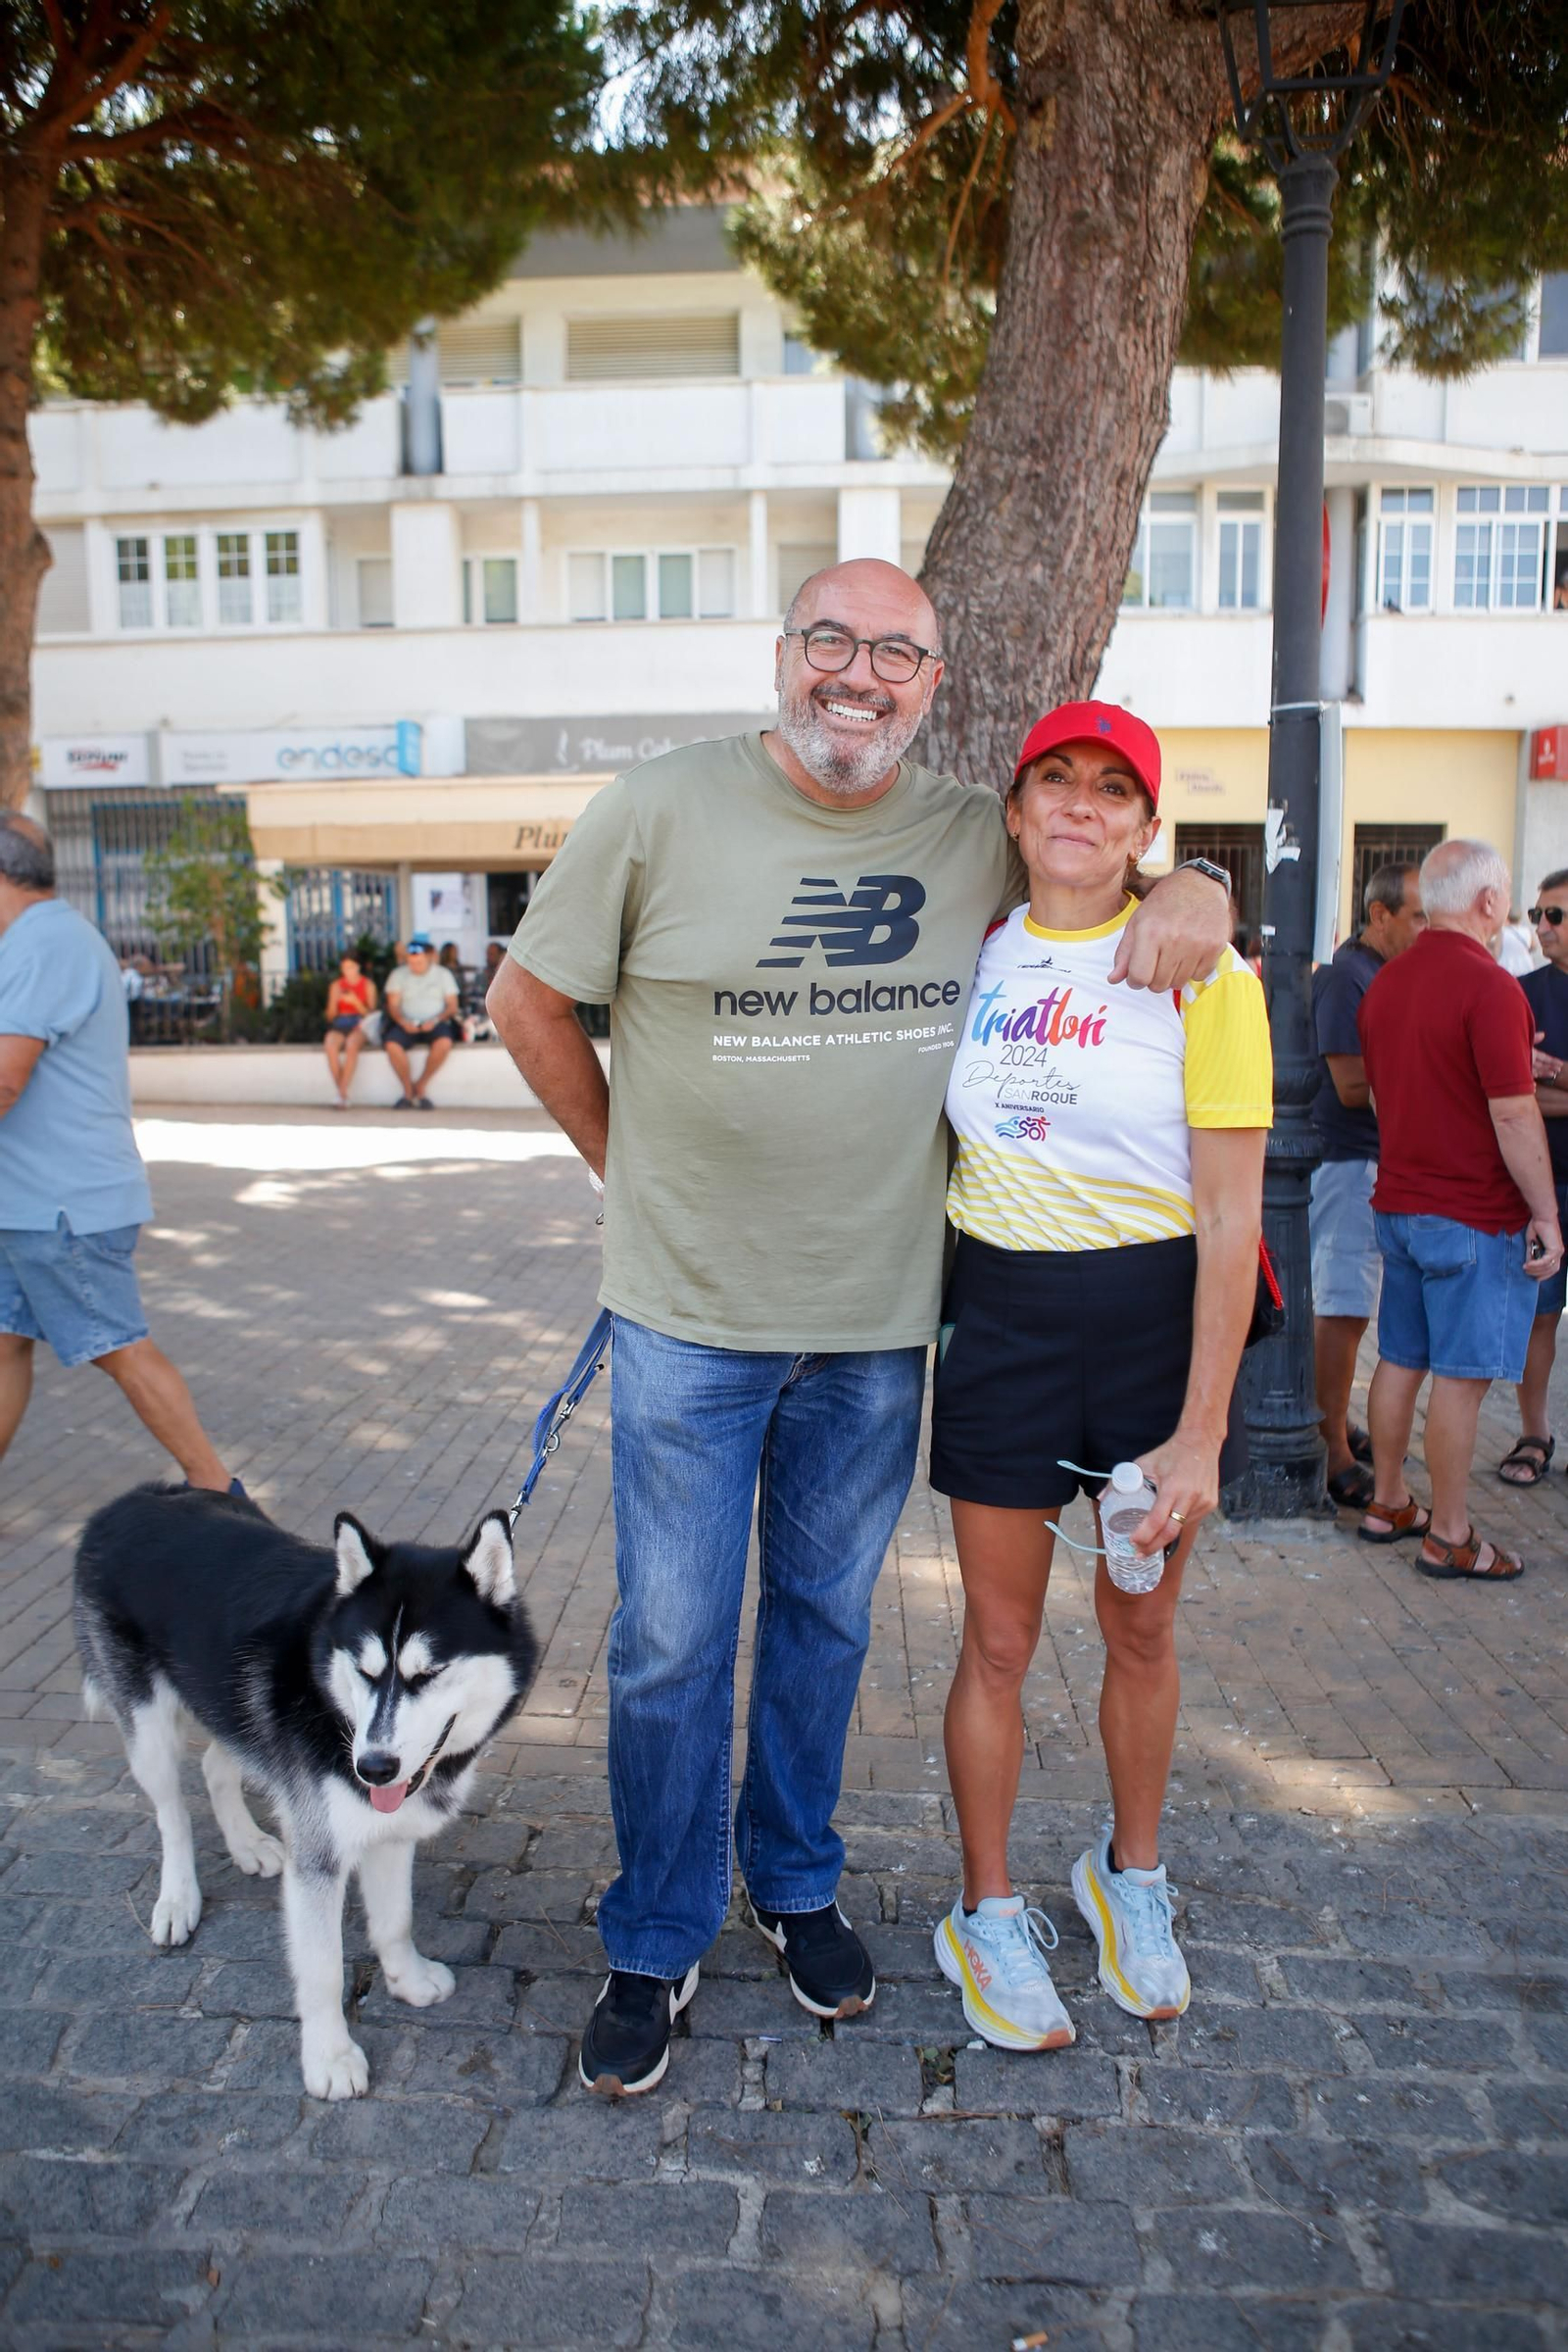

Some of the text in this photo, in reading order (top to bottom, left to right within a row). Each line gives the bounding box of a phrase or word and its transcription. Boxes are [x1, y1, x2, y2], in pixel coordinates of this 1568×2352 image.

[579, 737, 632, 760] Plum
[514, 825, 569, 850] Plu
[713, 980, 960, 1016] new balance
[712, 1022, 955, 1048] NEW BALANCE ATHLETIC SHOES INC.
[711, 1054, 811, 1063] BOSTON, MASSACHUSETTS
[1000, 1044, 1048, 1067] 2024
[962, 1060, 1081, 1099] Deportes
[1001, 1102, 1045, 1113] ANIVERSARIO
